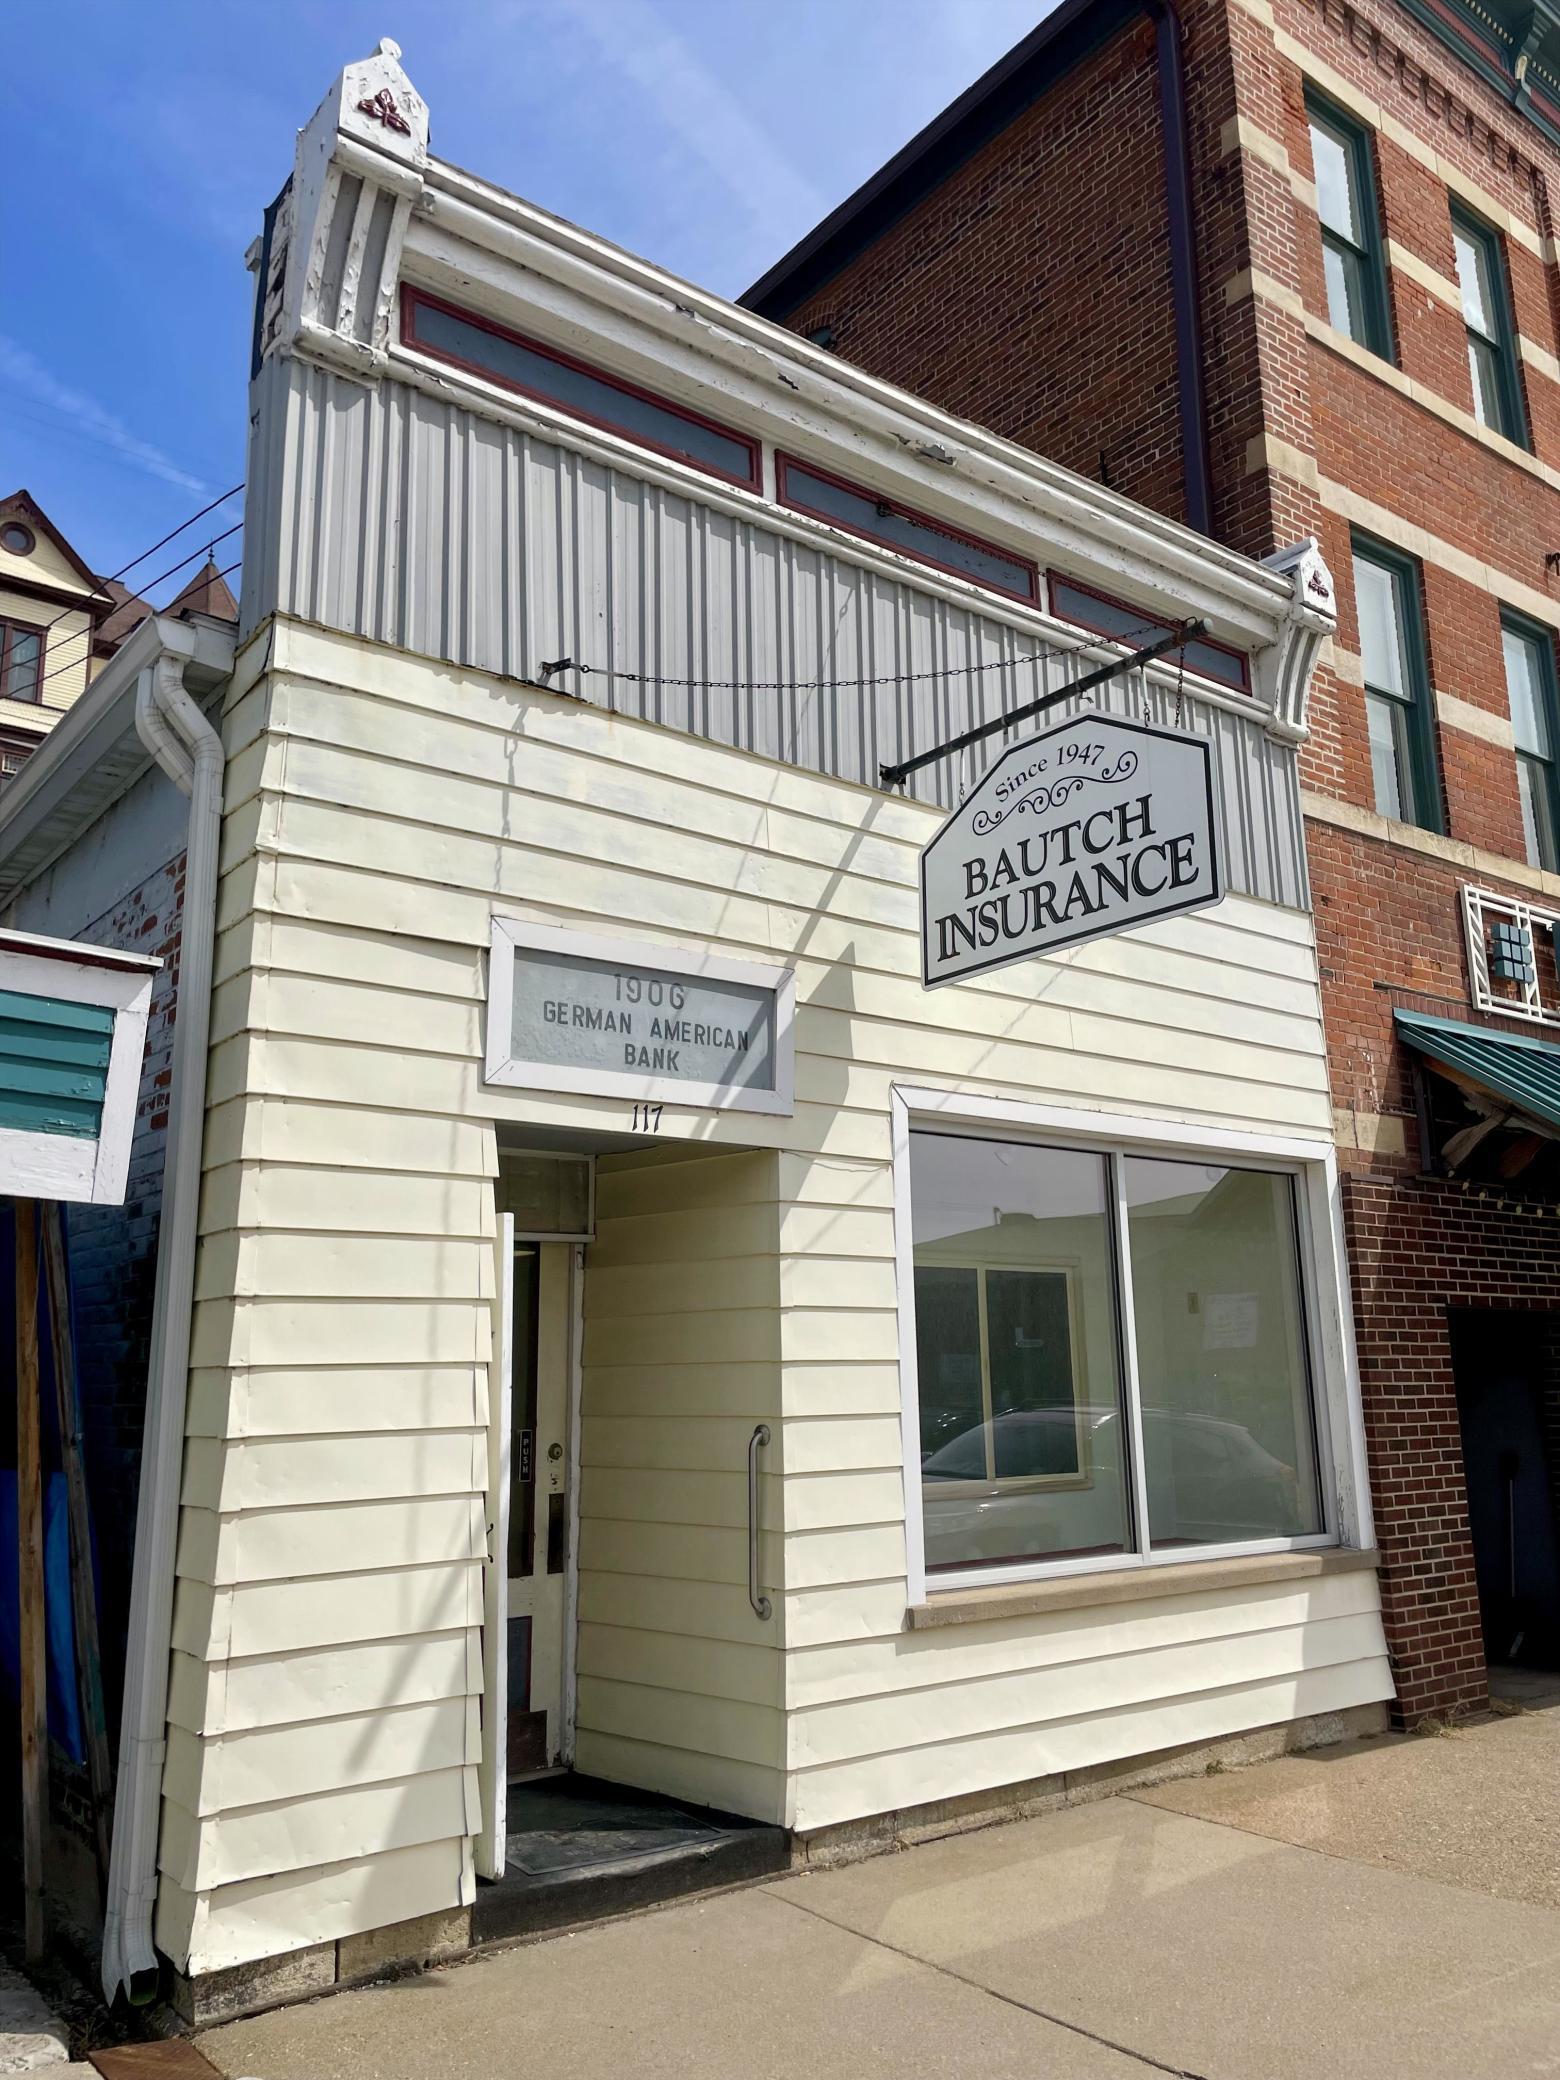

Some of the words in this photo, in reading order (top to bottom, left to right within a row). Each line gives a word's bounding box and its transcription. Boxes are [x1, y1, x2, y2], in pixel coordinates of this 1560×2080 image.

[995, 758, 1048, 803] Since
[1056, 743, 1105, 767] 1947
[962, 794, 1156, 900] BAUTCH
[934, 833, 1199, 962] INSURANCE
[614, 973, 685, 1010] 1906
[543, 1000, 632, 1034] GERMAN
[650, 1017, 749, 1051] AMERICAN
[625, 1043, 680, 1072] BANK
[632, 1104, 664, 1133] 117
